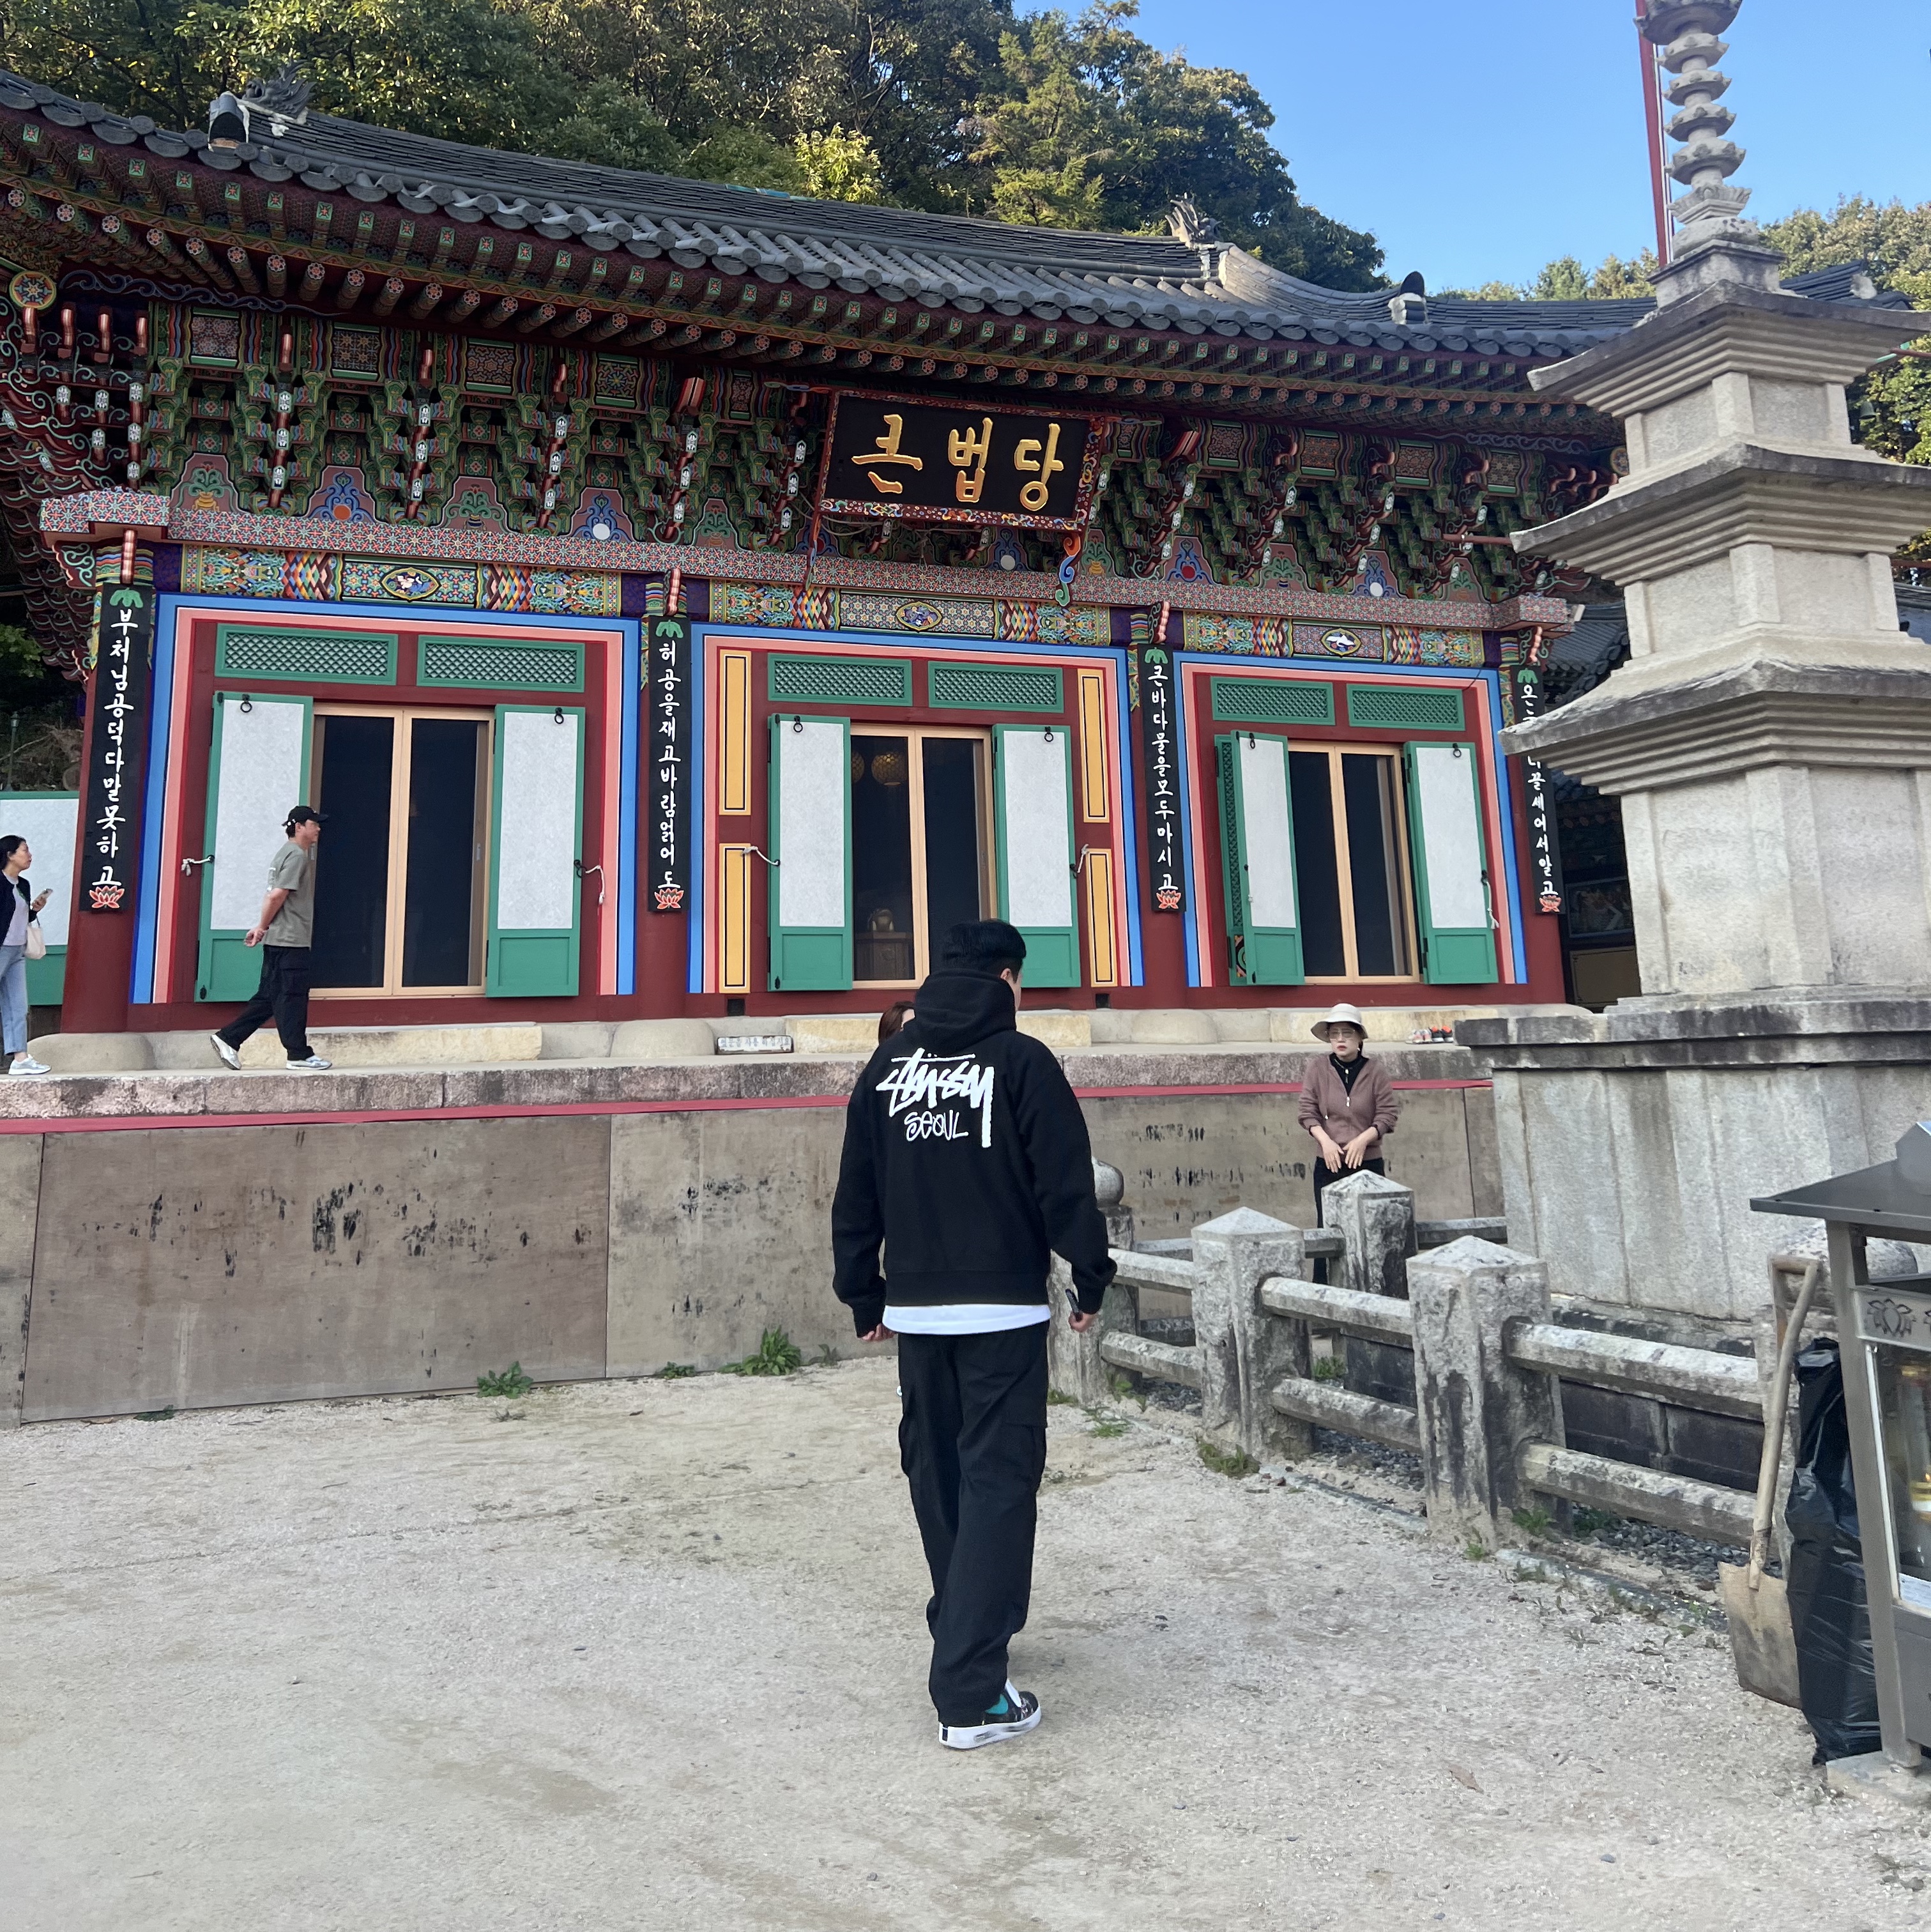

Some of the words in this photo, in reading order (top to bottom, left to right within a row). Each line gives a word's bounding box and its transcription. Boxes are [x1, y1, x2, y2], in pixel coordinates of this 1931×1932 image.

[851, 413, 1064, 511] 큰법당
[1520, 684, 1559, 896] 온누끌세어서알고
[745, 1036, 759, 1047] 사용
